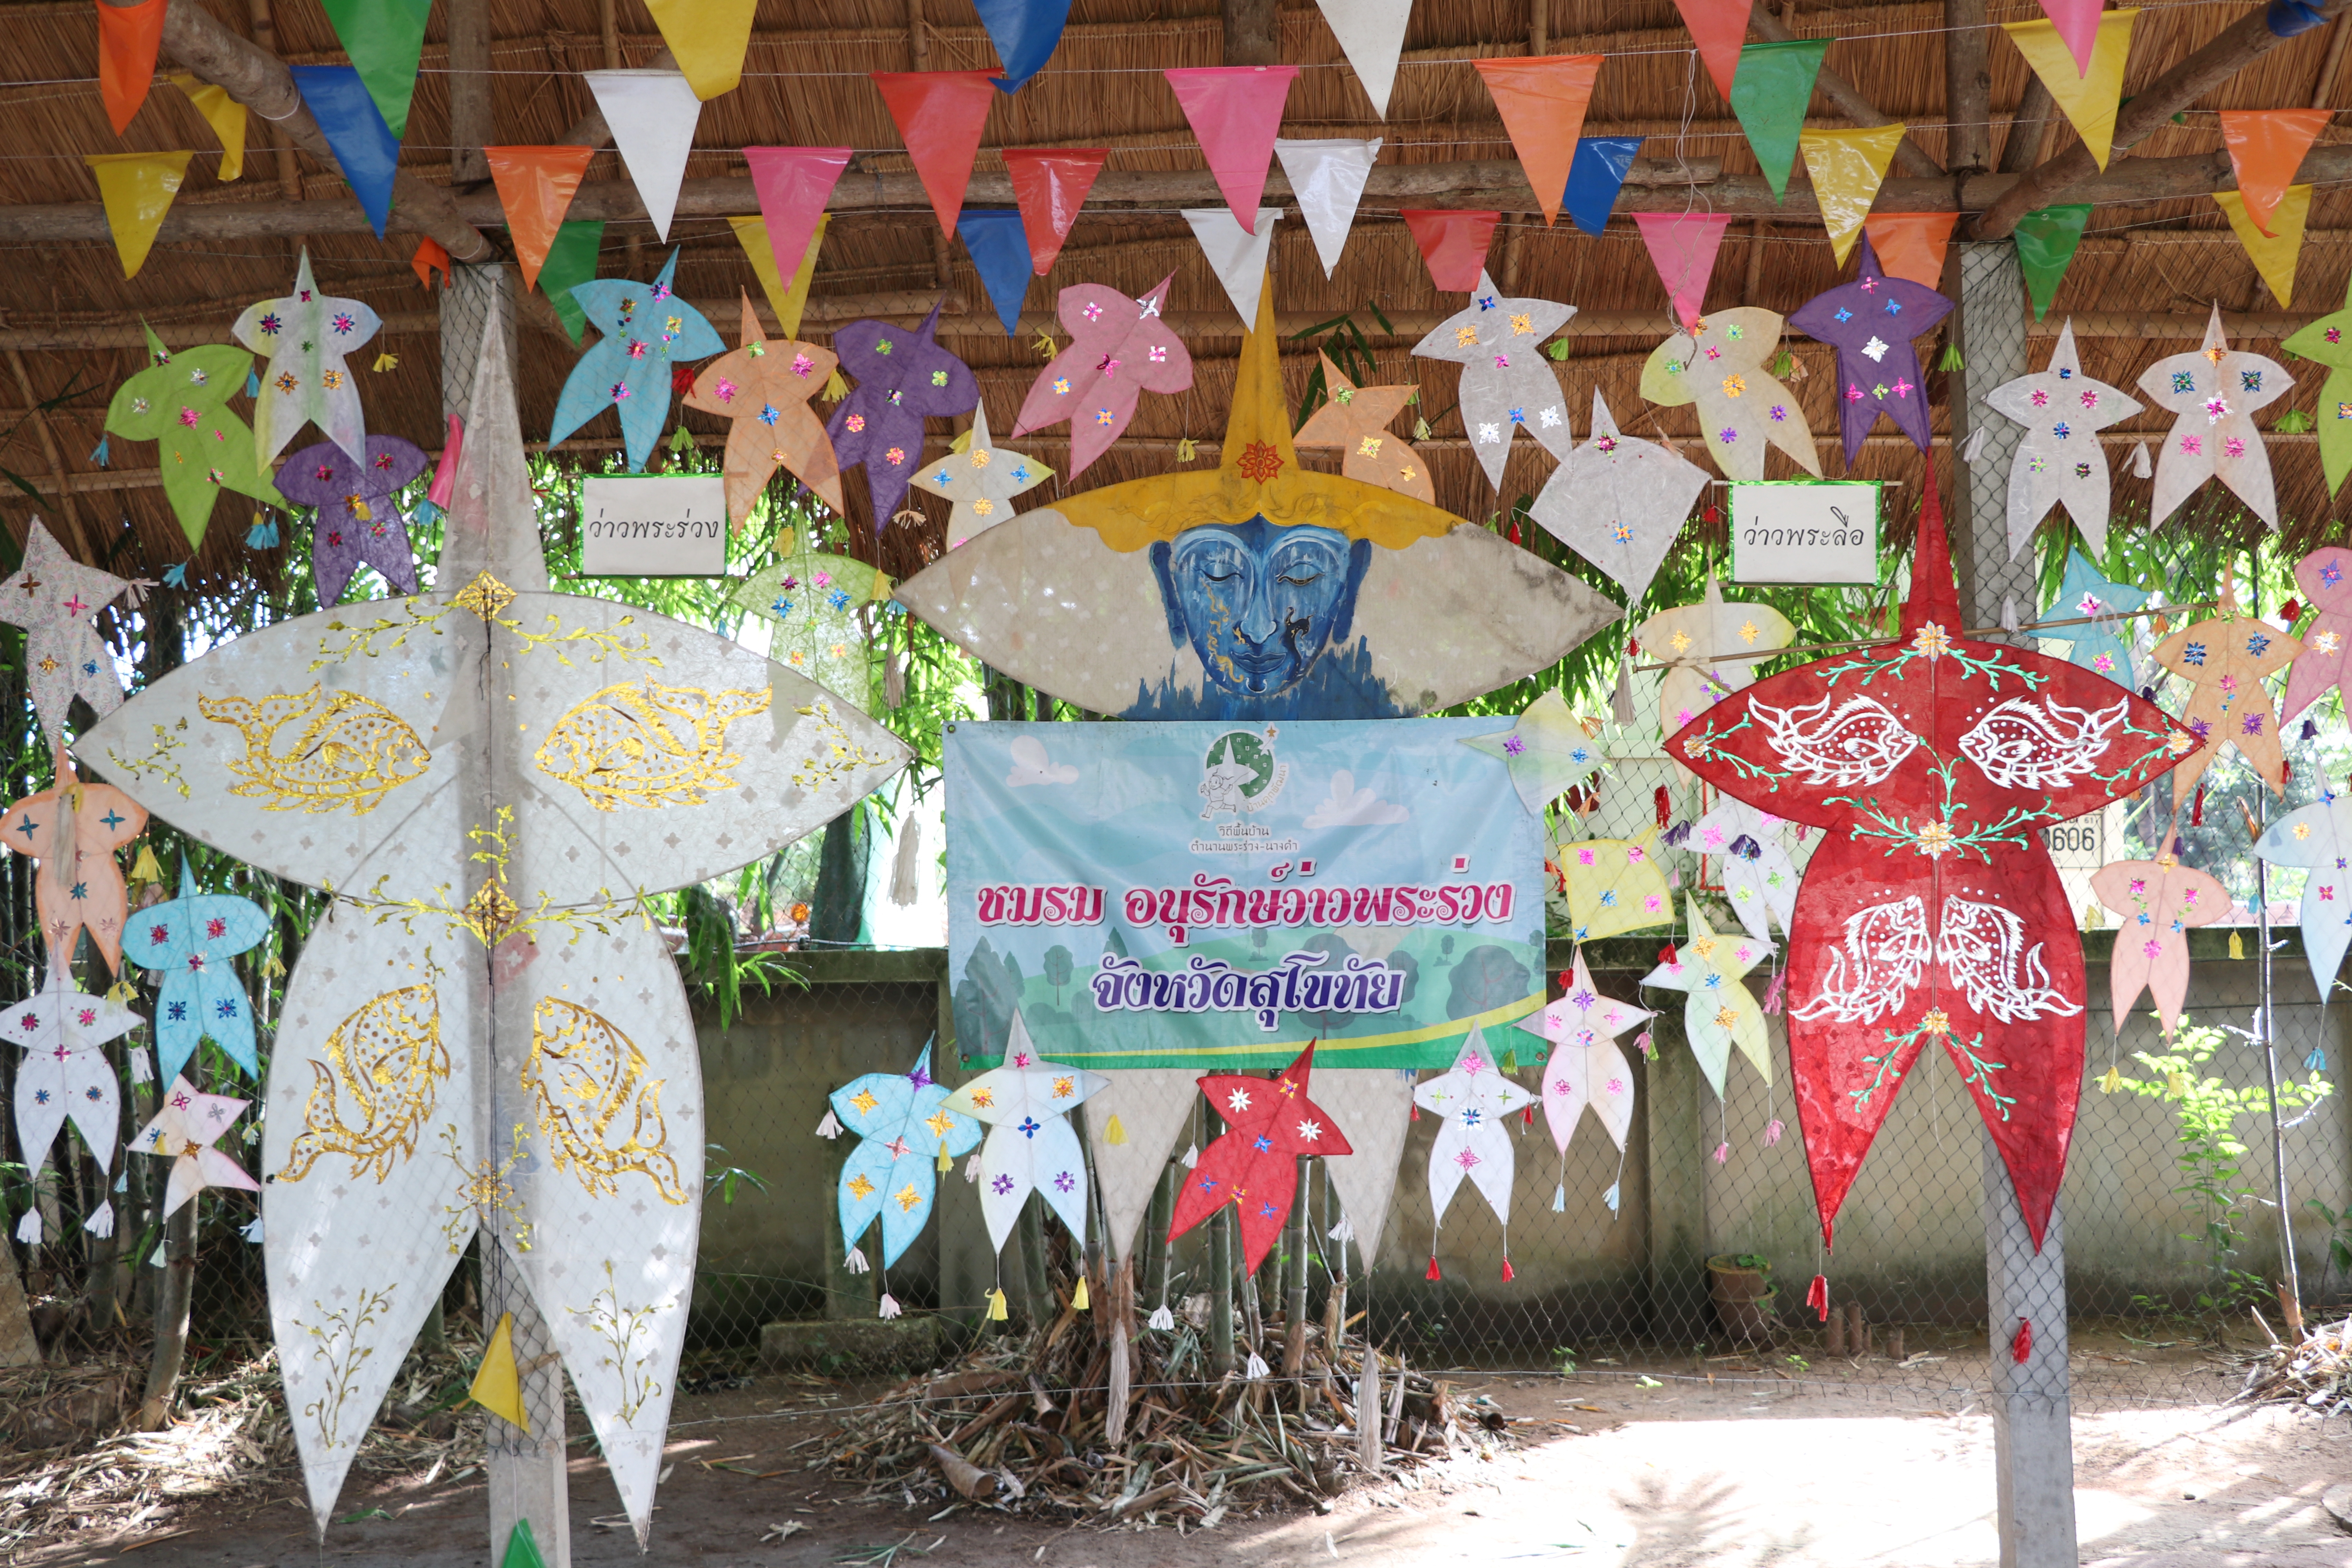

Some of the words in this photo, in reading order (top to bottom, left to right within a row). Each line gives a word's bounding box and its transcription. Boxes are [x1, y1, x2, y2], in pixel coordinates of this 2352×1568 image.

[590, 508, 718, 538] ว่าวพระร่วง
[1744, 506, 1864, 546] ว่าวพระลือ
[1191, 839, 1298, 851] ตำนานพระร่วง-นางคำ
[1218, 822, 1269, 836] วิถีพื้นบ้าน
[978, 884, 1103, 922] ชมรม
[1125, 858, 1512, 943] อนุรักษ์ว่าวพระร่วง
[1092, 954, 1405, 1027] จังหวัดสุโขทัย
